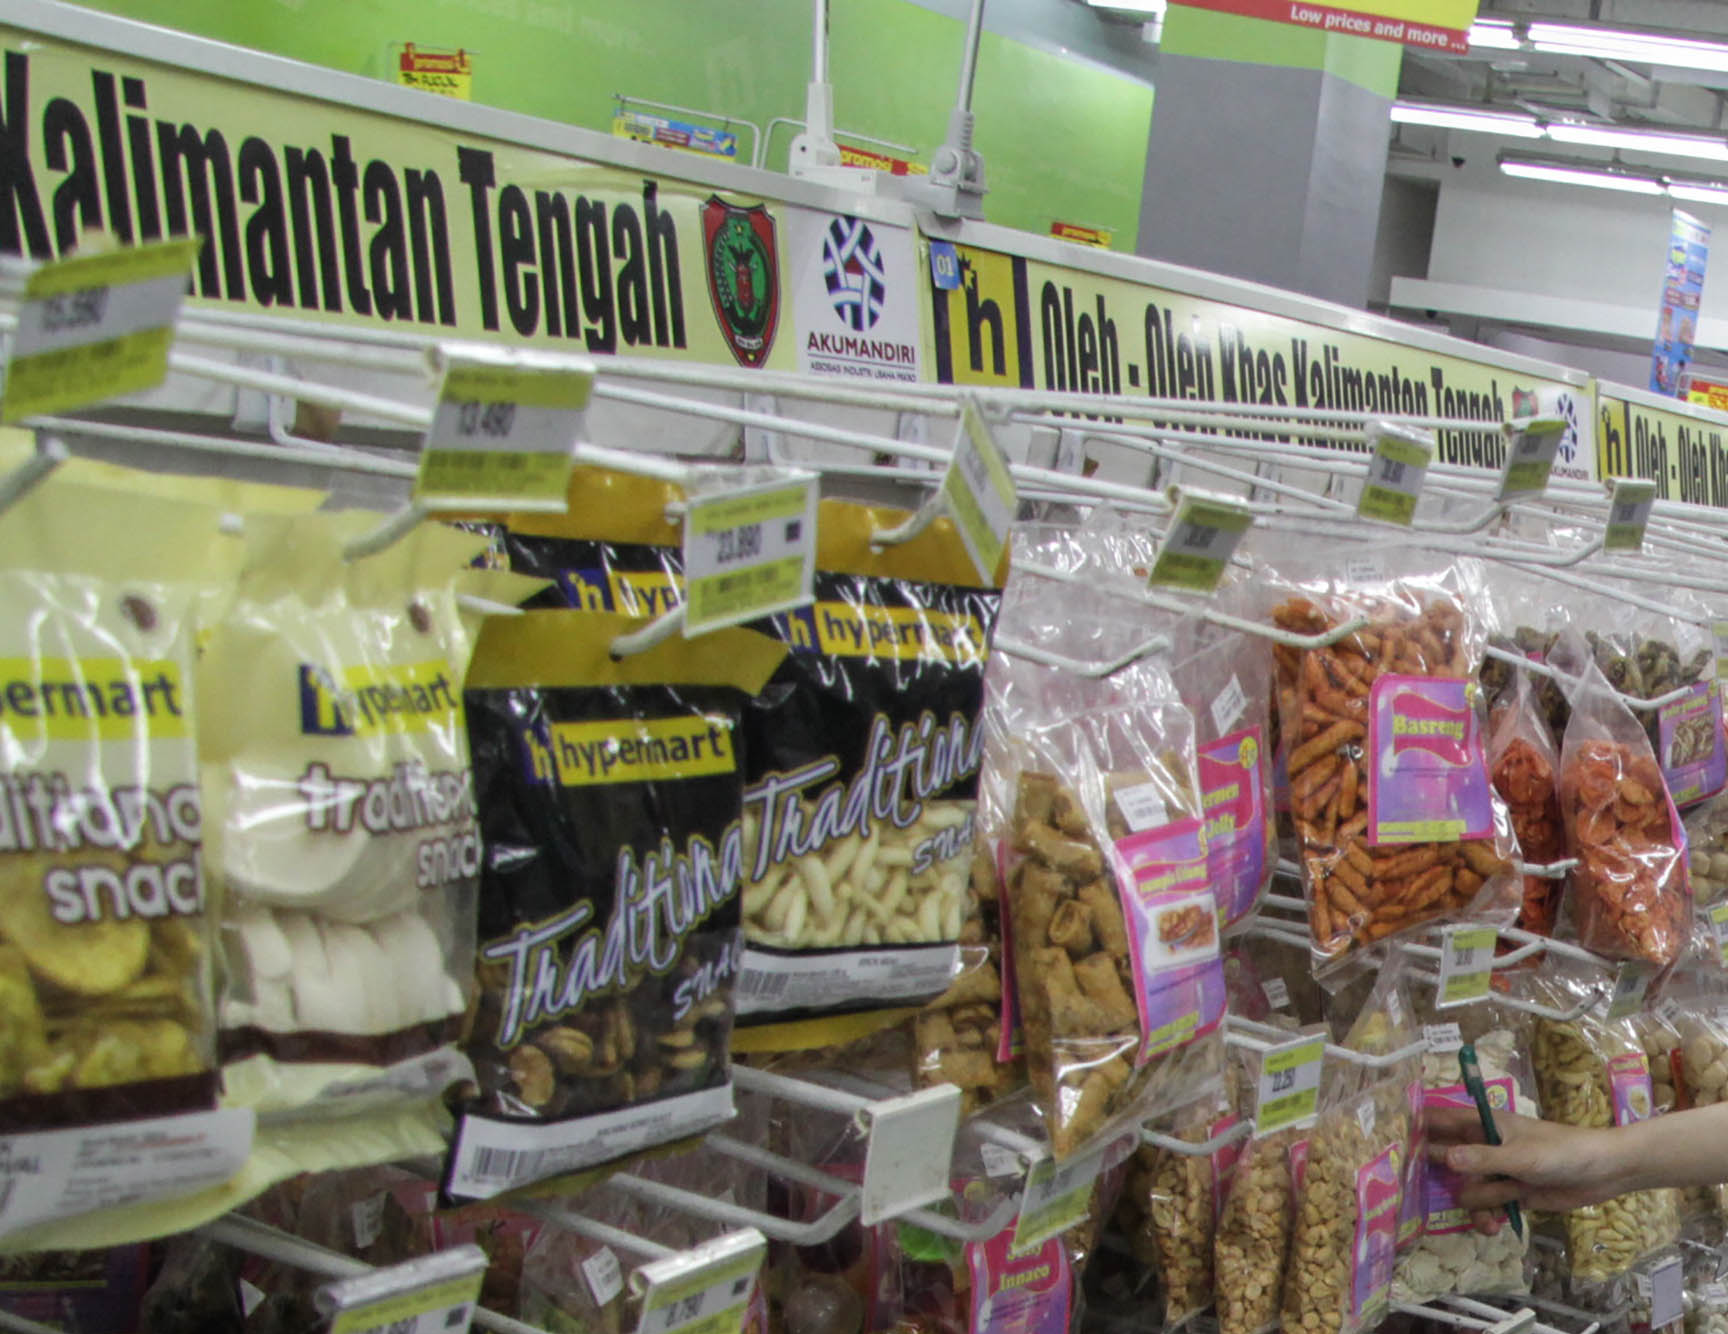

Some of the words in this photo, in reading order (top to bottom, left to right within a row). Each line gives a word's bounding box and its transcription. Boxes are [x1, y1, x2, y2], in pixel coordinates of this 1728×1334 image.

[1289, 5, 1321, 23] Low
[1323, 12, 1371, 34] prices
[1373, 22, 1404, 39] and
[1406, 30, 1448, 47] more
[0, 50, 457, 328] Kalimantan
[457, 144, 688, 356] Tengah
[936, 253, 955, 277] 01
[807, 331, 916, 364] AKUMANDIRI
[0, 673, 183, 718] ermart
[560, 724, 728, 777] hypermart
[1392, 713, 1465, 741] Basreng
[743, 710, 985, 880] Traditiona
[416, 829, 484, 889] snac
[45, 852, 205, 924] snac
[485, 833, 743, 1046] Traditiona
